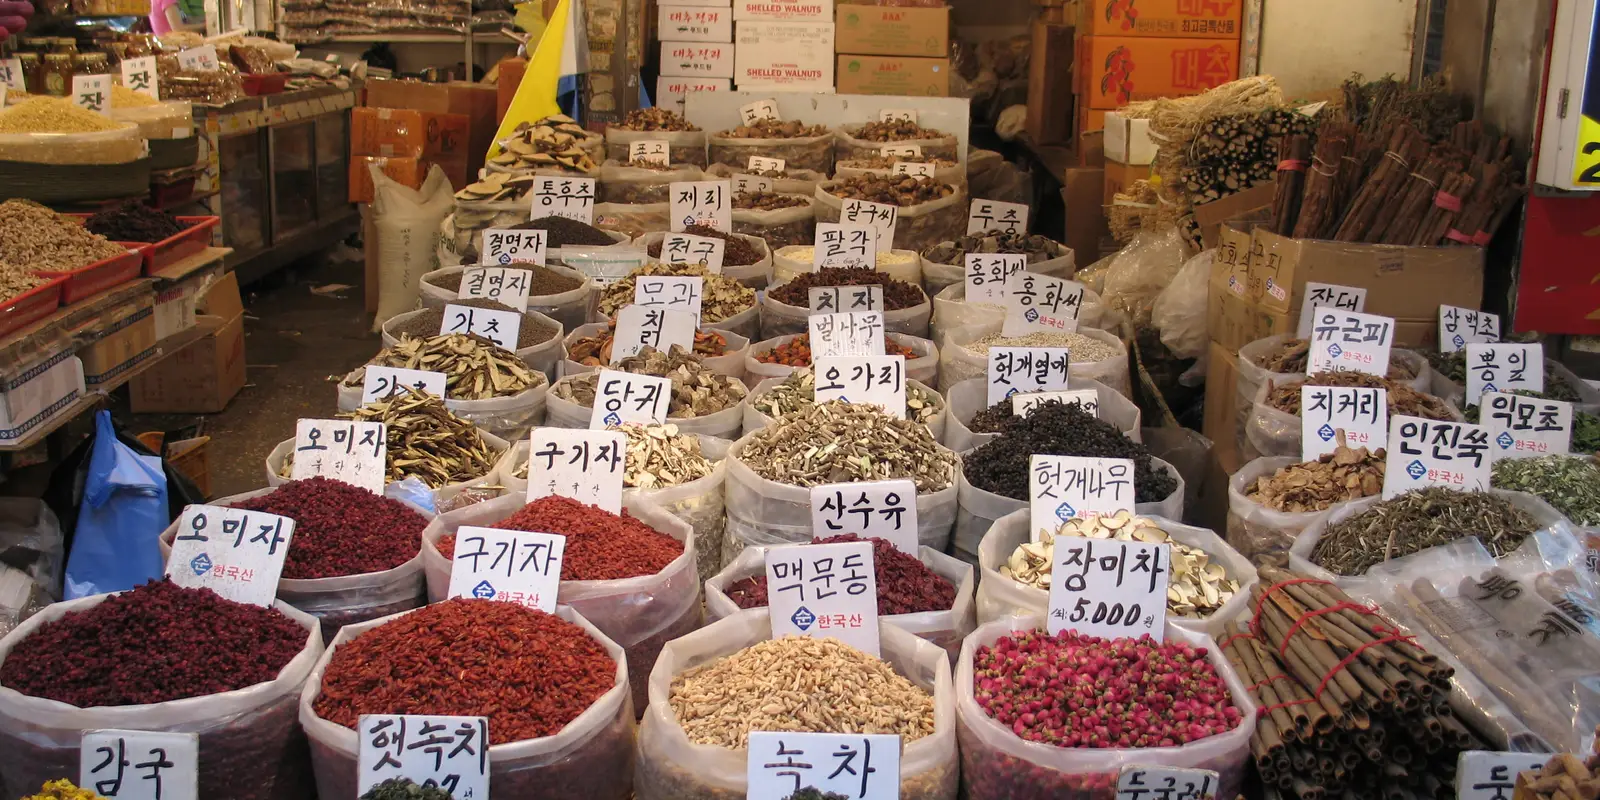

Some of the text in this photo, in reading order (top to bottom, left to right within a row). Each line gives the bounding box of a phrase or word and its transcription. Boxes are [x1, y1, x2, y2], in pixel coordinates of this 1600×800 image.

[746, 4, 822, 14] SHELLED WALNUTS
[1182, 20, 1234, 33] 최고급특산품
[129, 71, 151, 90] 잣
[746, 69, 822, 79] SHELLED WALNUTS
[1173, 47, 1231, 89] 대추
[80, 91, 105, 111] 잣
[634, 143, 665, 156] 표고
[535, 180, 594, 207] 통후추
[846, 201, 895, 229] 살구씨
[972, 205, 1021, 237] 두충
[489, 233, 542, 257] 결명자
[668, 238, 715, 265] 천궁
[822, 230, 870, 257] 팔각
[467, 269, 527, 297] 결명자
[968, 257, 1024, 285] 홍화씨
[640, 282, 698, 305] 모과
[816, 286, 875, 314] 치자
[1013, 276, 1084, 320] 홍화씨
[1039, 315, 1065, 329] 한국산
[1315, 314, 1389, 346] 유근피
[1443, 308, 1498, 338] 삼백초
[993, 352, 1068, 385] 헛개열매
[1343, 351, 1372, 364] 한국산
[1471, 348, 1527, 382] 뽕잎
[816, 361, 900, 393] 오가피
[604, 380, 663, 416] 당귀
[1308, 388, 1378, 425] 치커리
[1492, 396, 1563, 431] 익모초
[298, 424, 385, 458] 오미자
[1347, 431, 1369, 443] 국산
[1400, 422, 1489, 468] 인진쑥
[1515, 439, 1548, 453] 한국산
[535, 440, 621, 473] 구기자
[1034, 461, 1130, 501] 헛개나무
[1427, 470, 1464, 485] 한국산
[819, 491, 906, 530] 산수유
[177, 513, 285, 555] 오미자
[458, 537, 557, 577] 구기자
[1062, 541, 1164, 593] 장미차
[212, 565, 254, 582] 한국산
[772, 554, 868, 602] 맥문동
[817, 614, 863, 629] 한국산
[1069, 597, 1141, 627] 5.000
[1143, 614, 1155, 629] 원
[370, 717, 489, 775] 햇녹차
[91, 738, 175, 800] 감국
[764, 738, 876, 799] 녹차
